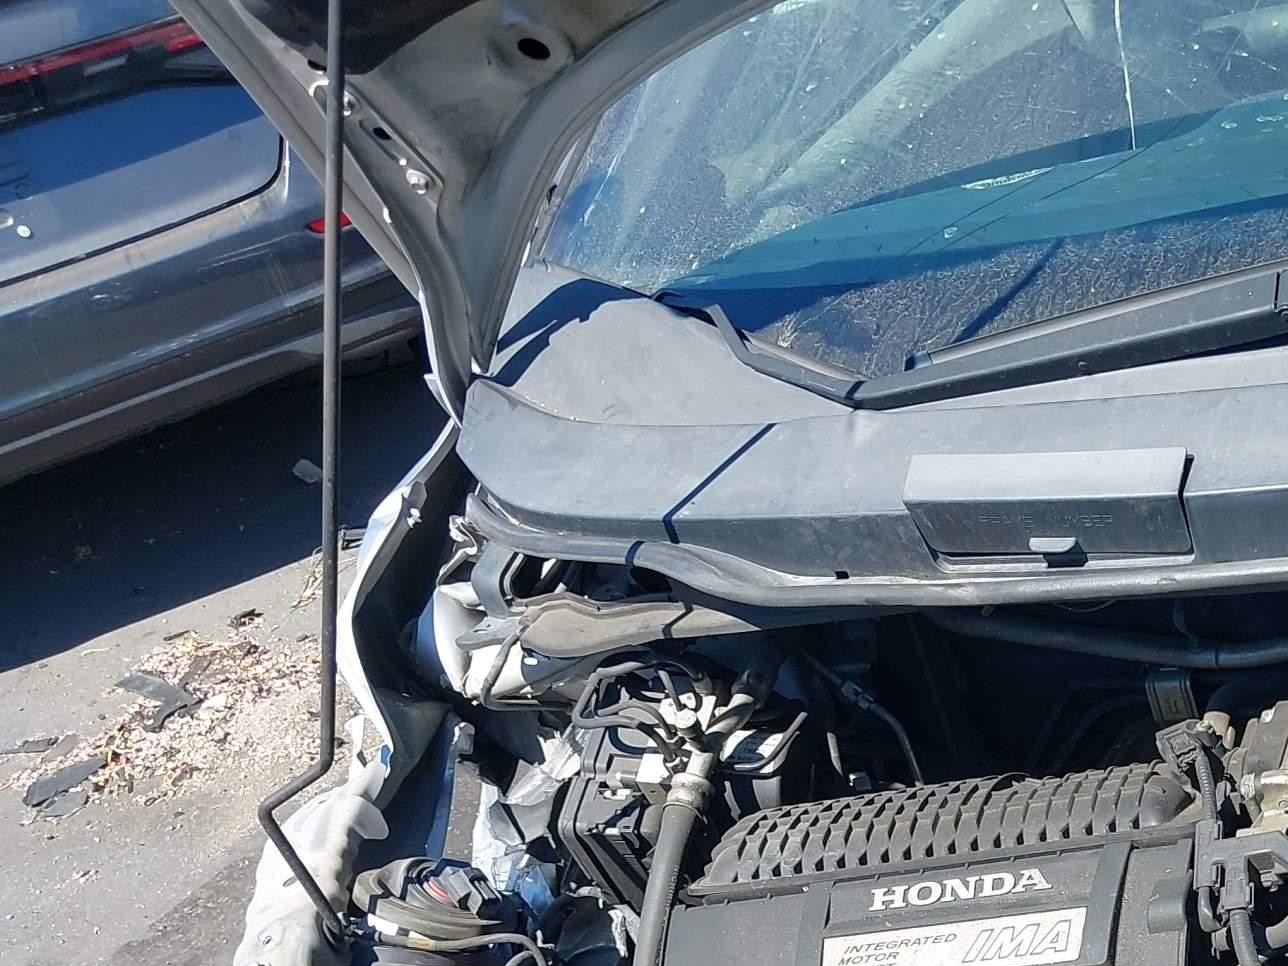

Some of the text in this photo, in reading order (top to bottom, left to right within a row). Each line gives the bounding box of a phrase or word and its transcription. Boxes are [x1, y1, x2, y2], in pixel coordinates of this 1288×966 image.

[868, 868, 1053, 911] HONDA
[843, 932, 958, 955] INTEGRATED
[962, 919, 1073, 964] IMA
[838, 951, 900, 966] MOTOR
